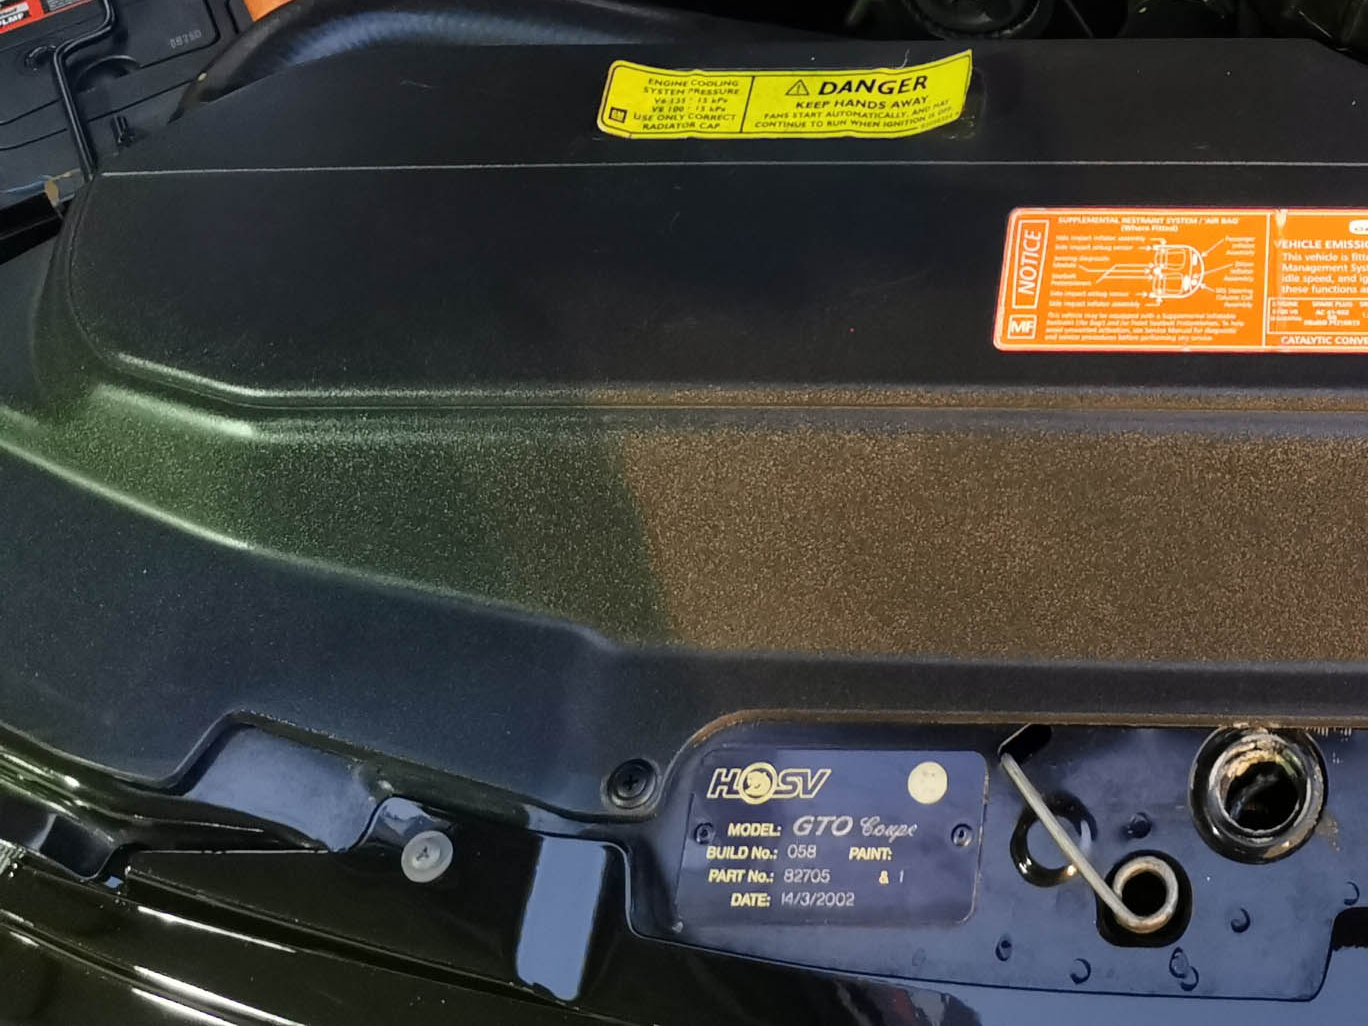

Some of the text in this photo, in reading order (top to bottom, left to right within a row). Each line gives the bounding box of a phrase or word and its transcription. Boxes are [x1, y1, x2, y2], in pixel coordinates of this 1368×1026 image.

[648, 78, 739, 87] ENGINE COOLING
[818, 76, 928, 96] DANGER
[644, 86, 685, 95] SYSTEM
[796, 95, 928, 110] KEEP HANDS AWAY
[634, 112, 653, 121] USE
[688, 112, 736, 121] CORRECT
[642, 122, 696, 130] RADIATOR
[755, 120, 806, 128] CONTINUE
[810, 120, 824, 128] TO
[850, 120, 880, 128] WHEN
[882, 117, 926, 128] IGNITION
[1274, 240, 1321, 250] VEHICLE
[1018, 230, 1042, 294] NOTICE
[1282, 252, 1301, 263] This
[1305, 252, 1338, 263] vehicle
[1341, 252, 1349, 263] is
[1282, 263, 1347, 273] Management
[1282, 274, 1300, 284] idle
[1303, 274, 1334, 284] speed,
[1337, 274, 1355, 284] and
[1282, 285, 1308, 295] these
[1311, 285, 1357, 295] functions
[1010, 320, 1034, 334] MF
[1281, 336, 1333, 346] CATALYTIC
[727, 816, 918, 843] MODEL: GTO Coupe
[706, 844, 892, 861] BUILD No.: 058 PAINT:
[708, 870, 745, 883] PART
[747, 870, 774, 883] No.:
[783, 870, 831, 883] 82705
[878, 871, 889, 884] &
[731, 893, 855, 907] DATE: 14/3/2002
